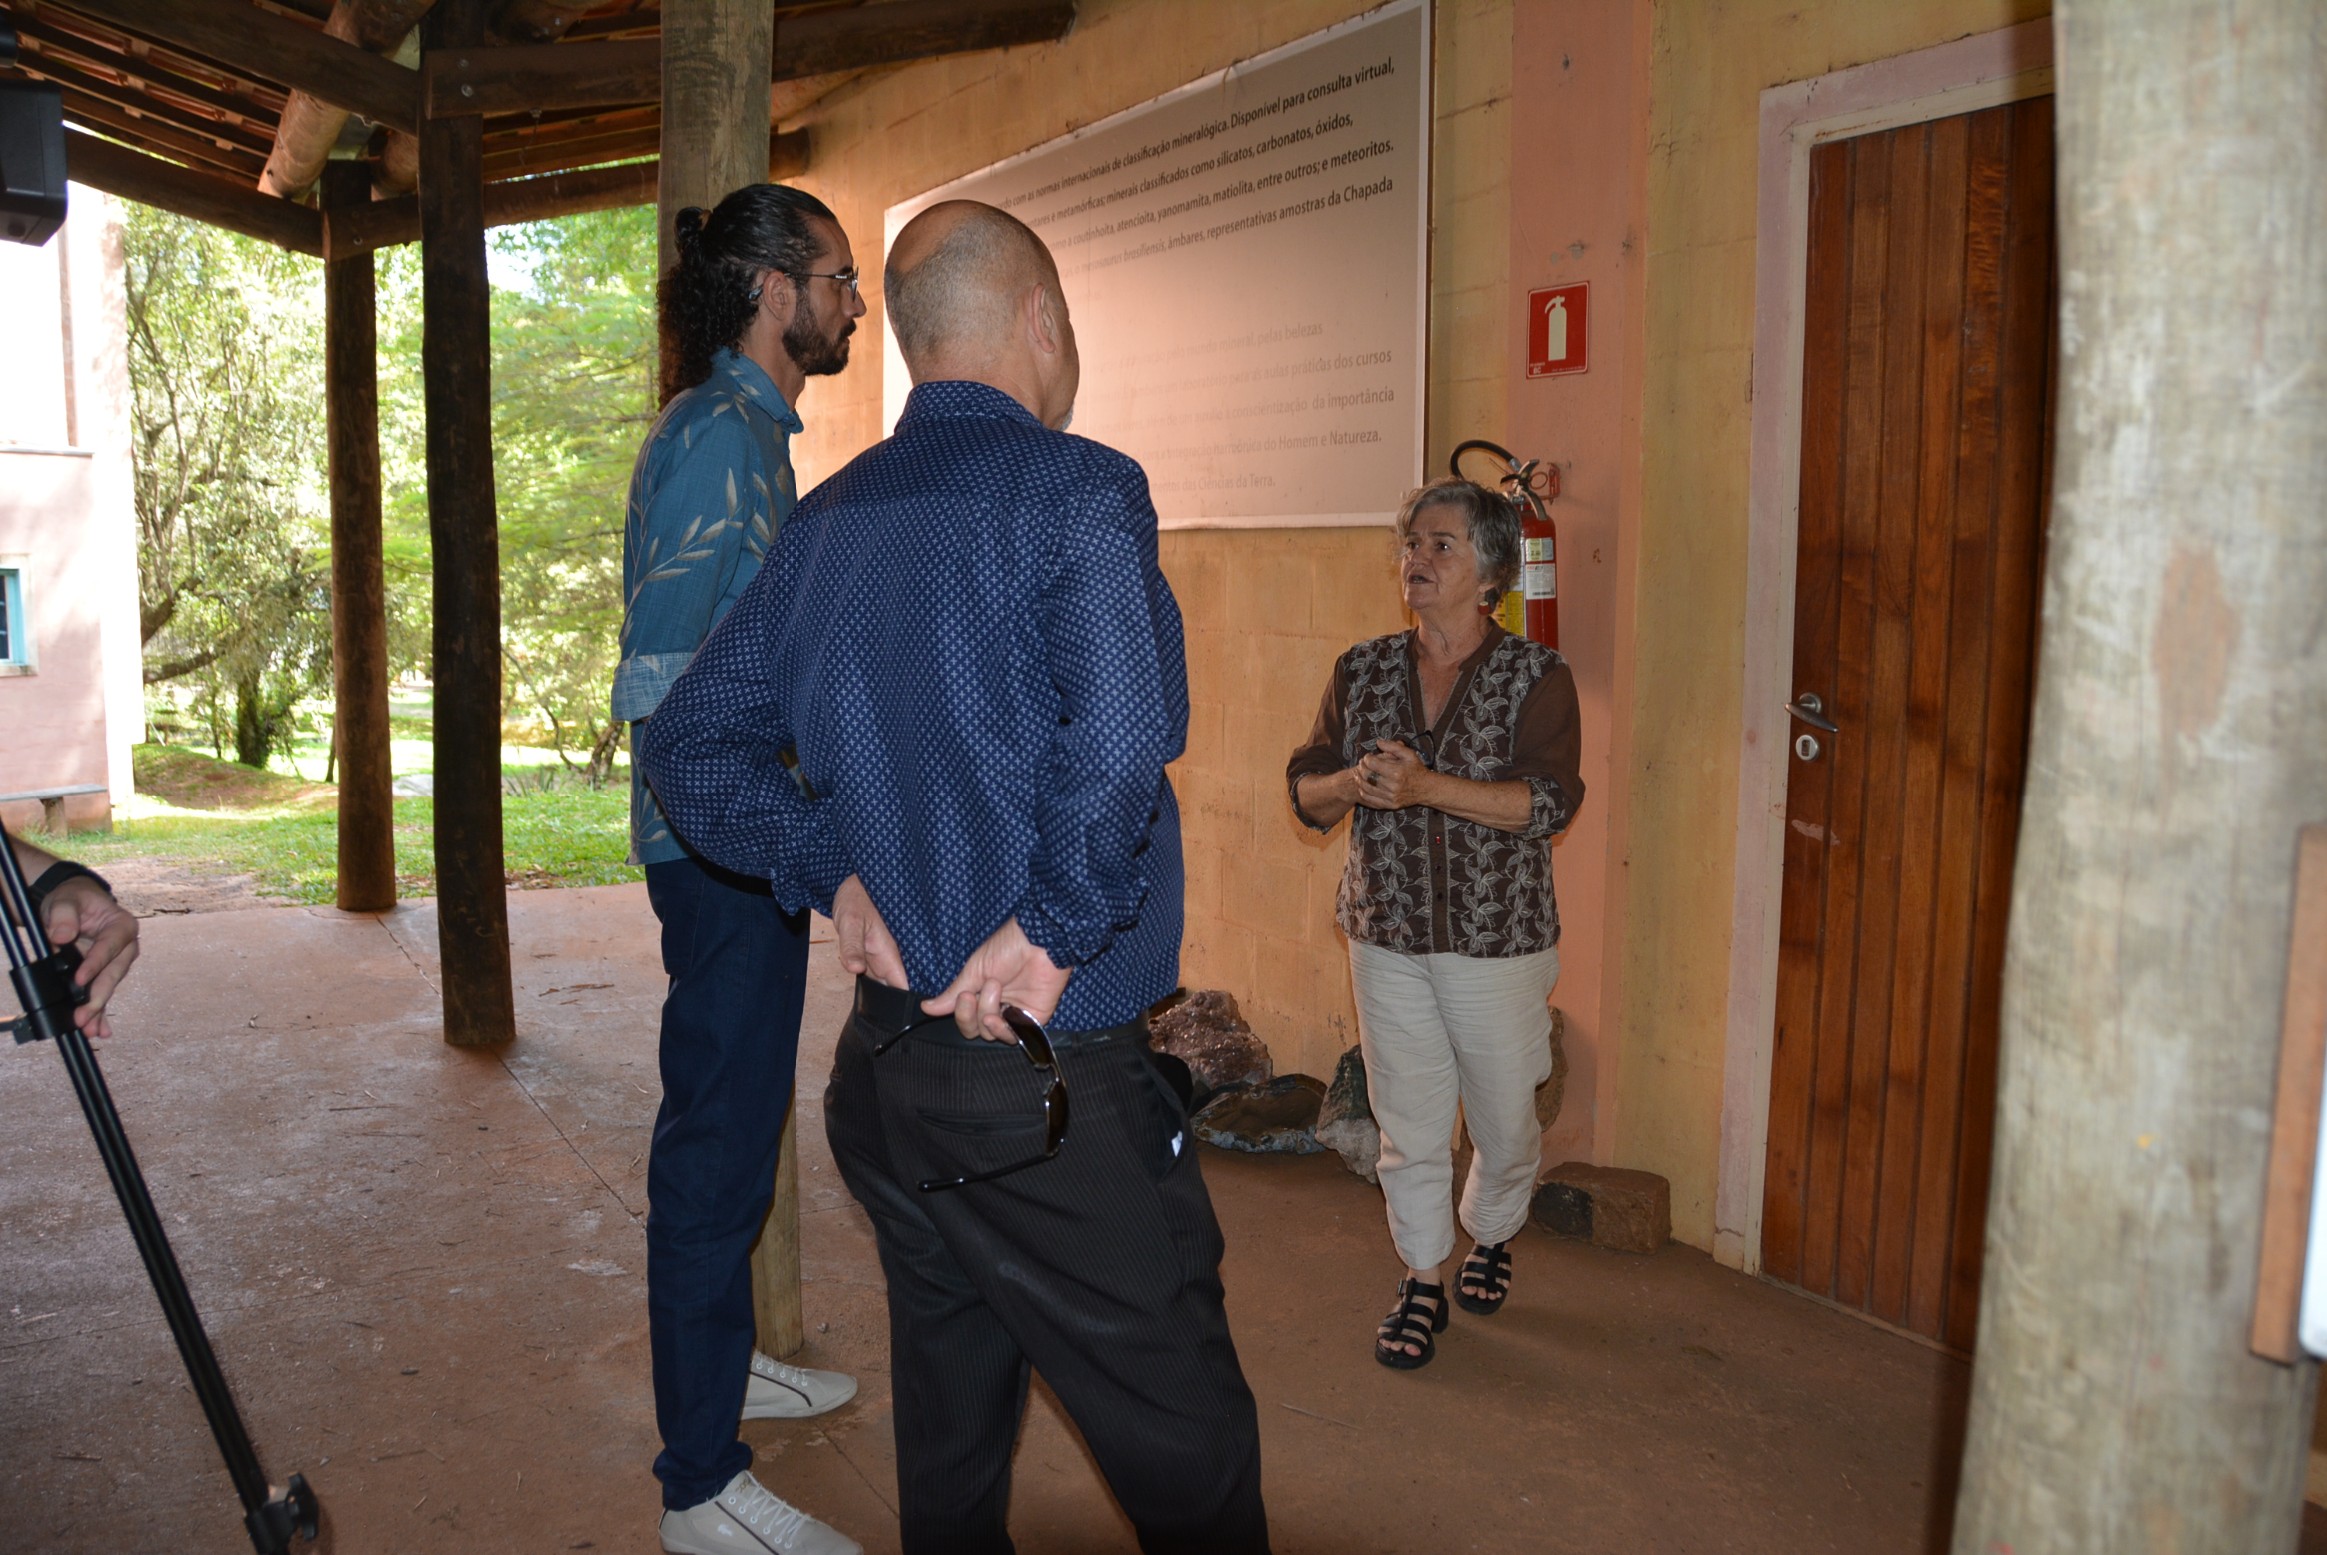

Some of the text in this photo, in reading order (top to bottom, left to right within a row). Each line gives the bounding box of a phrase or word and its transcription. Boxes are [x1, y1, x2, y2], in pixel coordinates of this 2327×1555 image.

[1013, 193, 1026, 206] com
[1028, 190, 1034, 201] as
[1036, 180, 1060, 198] normas
[1061, 161, 1111, 189] internacionais
[1112, 157, 1121, 171] de
[1123, 140, 1170, 167] classificação
[1172, 120, 1230, 150] mineralógica.
[1230, 97, 1281, 129] Disponível
[1282, 92, 1305, 114] para
[1307, 74, 1352, 102] consulta
[1354, 56, 1395, 85] virtual,
[1057, 196, 1106, 220] metamórficas;
[1106, 182, 1139, 206] minerais
[1140, 167, 1189, 194] classificados
[1191, 159, 1215, 176] como
[1217, 144, 1255, 168] silicatos,
[1256, 126, 1314, 156] carbonatos,
[1315, 113, 1353, 136] óxidos,
[1157, 193, 1212, 223] yanomamita,
[1213, 179, 1256, 202] matiolita,
[1257, 172, 1282, 190] entre
[1285, 160, 1321, 183] outros;
[1322, 159, 1328, 171] e
[1331, 140, 1394, 169] meteoritos.
[1168, 229, 1206, 250] âmbares,
[1207, 210, 1278, 239] representativas
[1279, 195, 1326, 220] amostras
[1328, 190, 1341, 206] da
[1343, 175, 1393, 202] Chapada
[1257, 327, 1283, 348] pelas
[1285, 322, 1324, 341] belezas
[1264, 362, 1289, 380] aulas
[1291, 355, 1332, 380] práticas
[1334, 352, 1354, 369] dos
[1356, 349, 1393, 367] cursos
[1232, 396, 1308, 420] conscientização
[1312, 392, 1325, 410] da
[1327, 384, 1395, 411] importância
[1264, 436, 1277, 452] do
[1279, 433, 1319, 451] Homem
[1321, 434, 1328, 447] e
[1329, 428, 1382, 447] Natureza.
[1236, 473, 1247, 489] da
[1248, 472, 1277, 489] Terra.
